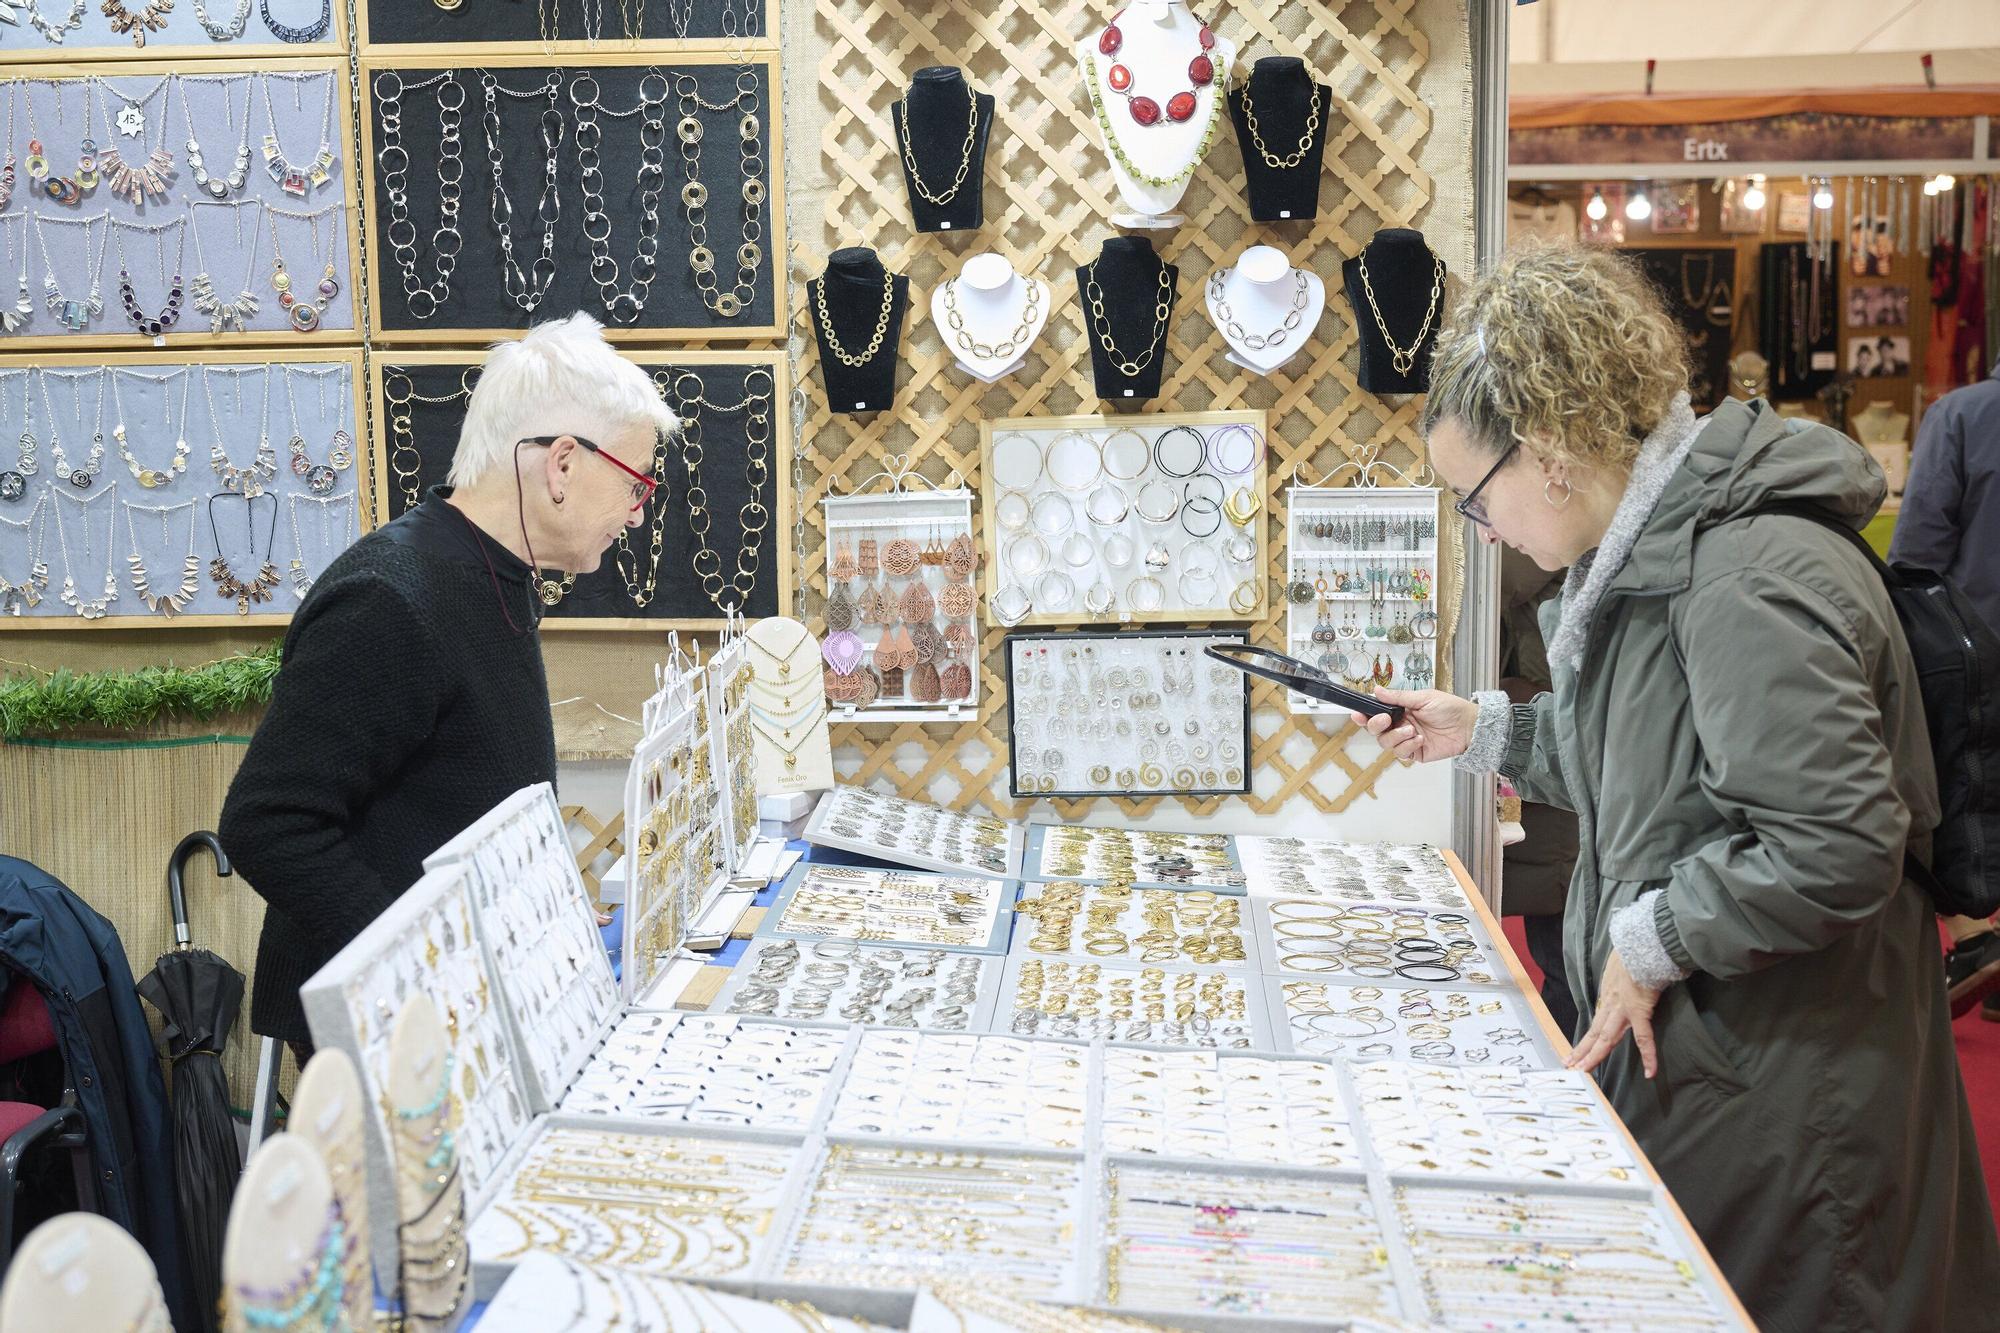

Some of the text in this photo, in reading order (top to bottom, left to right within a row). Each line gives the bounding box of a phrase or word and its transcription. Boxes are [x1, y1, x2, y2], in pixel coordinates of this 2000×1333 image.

[1684, 138, 1728, 161] Ertx
[777, 774, 808, 784] Fenix Oro
